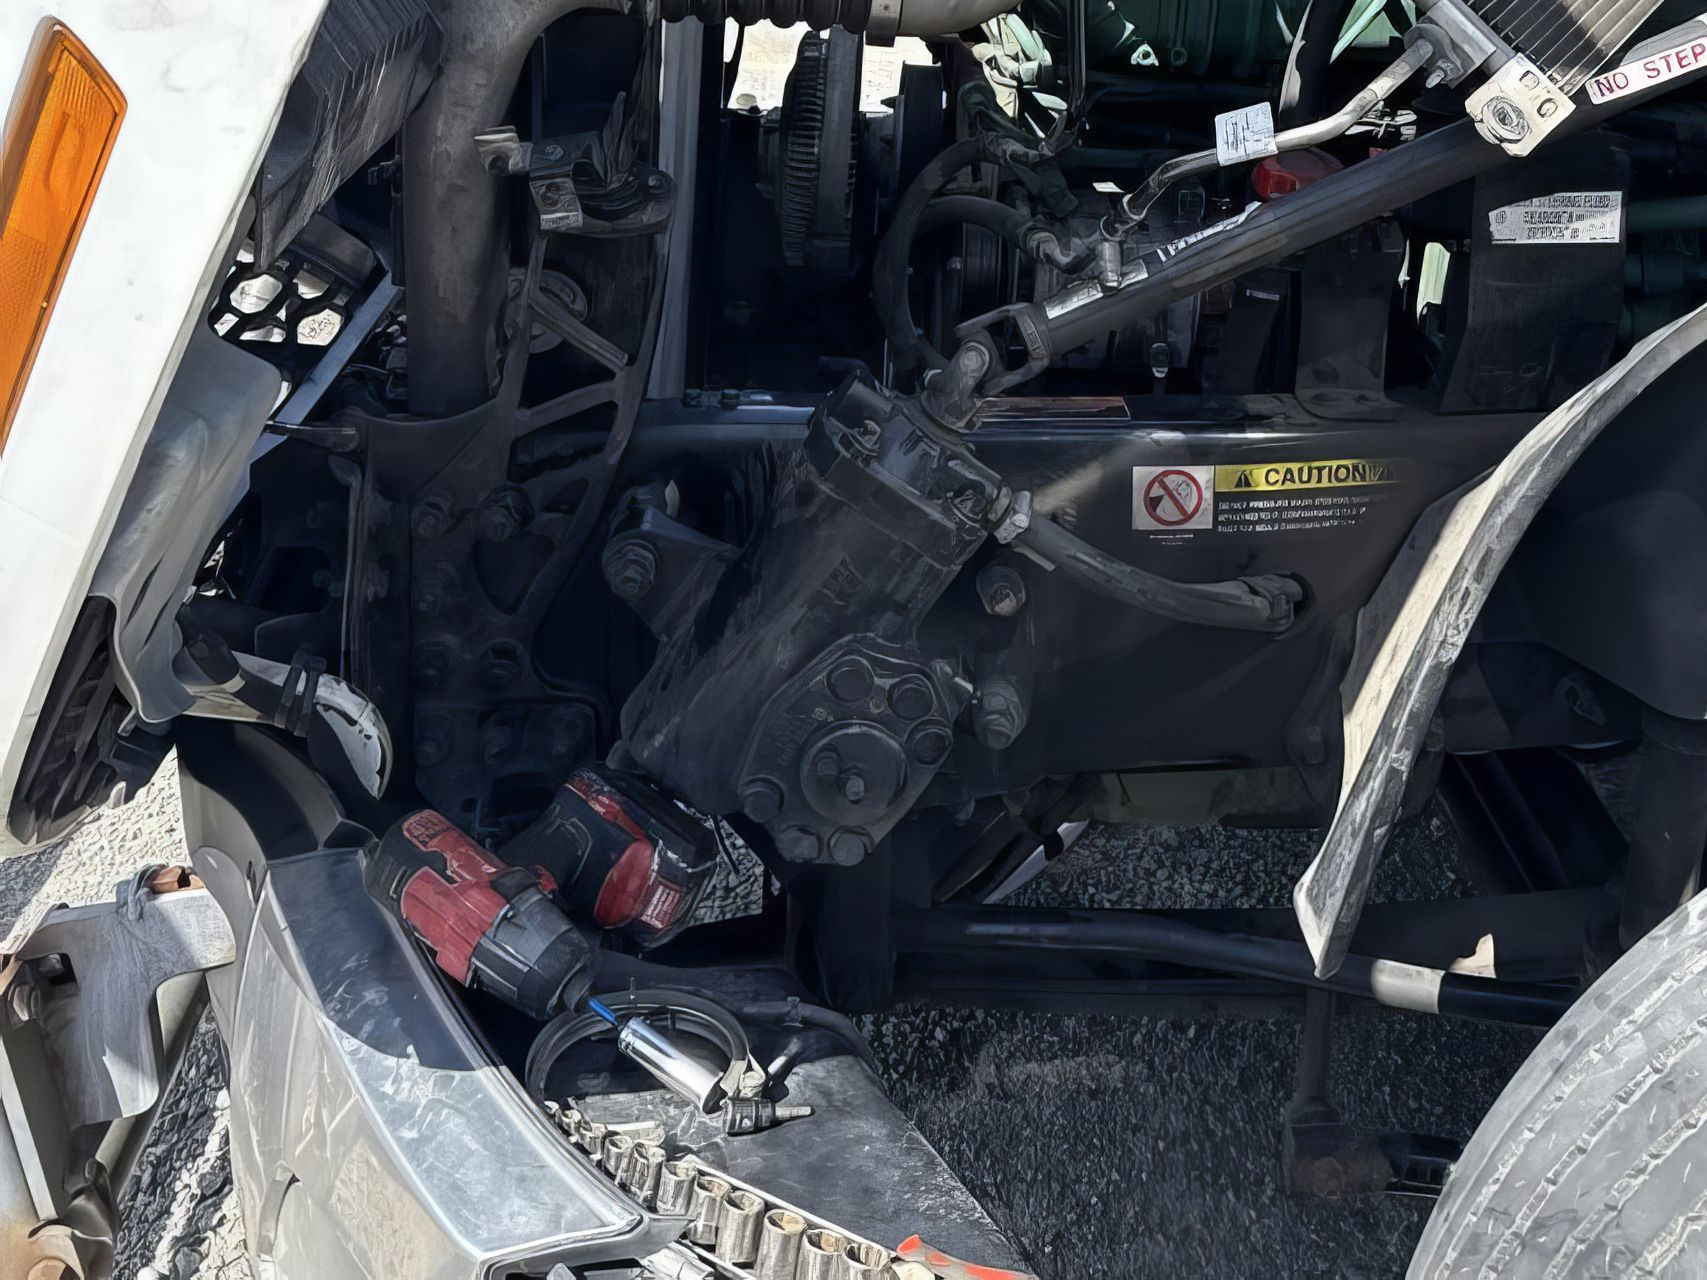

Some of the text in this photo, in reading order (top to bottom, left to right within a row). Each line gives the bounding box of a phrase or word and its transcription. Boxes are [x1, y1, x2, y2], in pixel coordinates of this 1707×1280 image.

[1594, 43, 1706, 97] NO STEP
[1264, 463, 1367, 486] CAUTION
